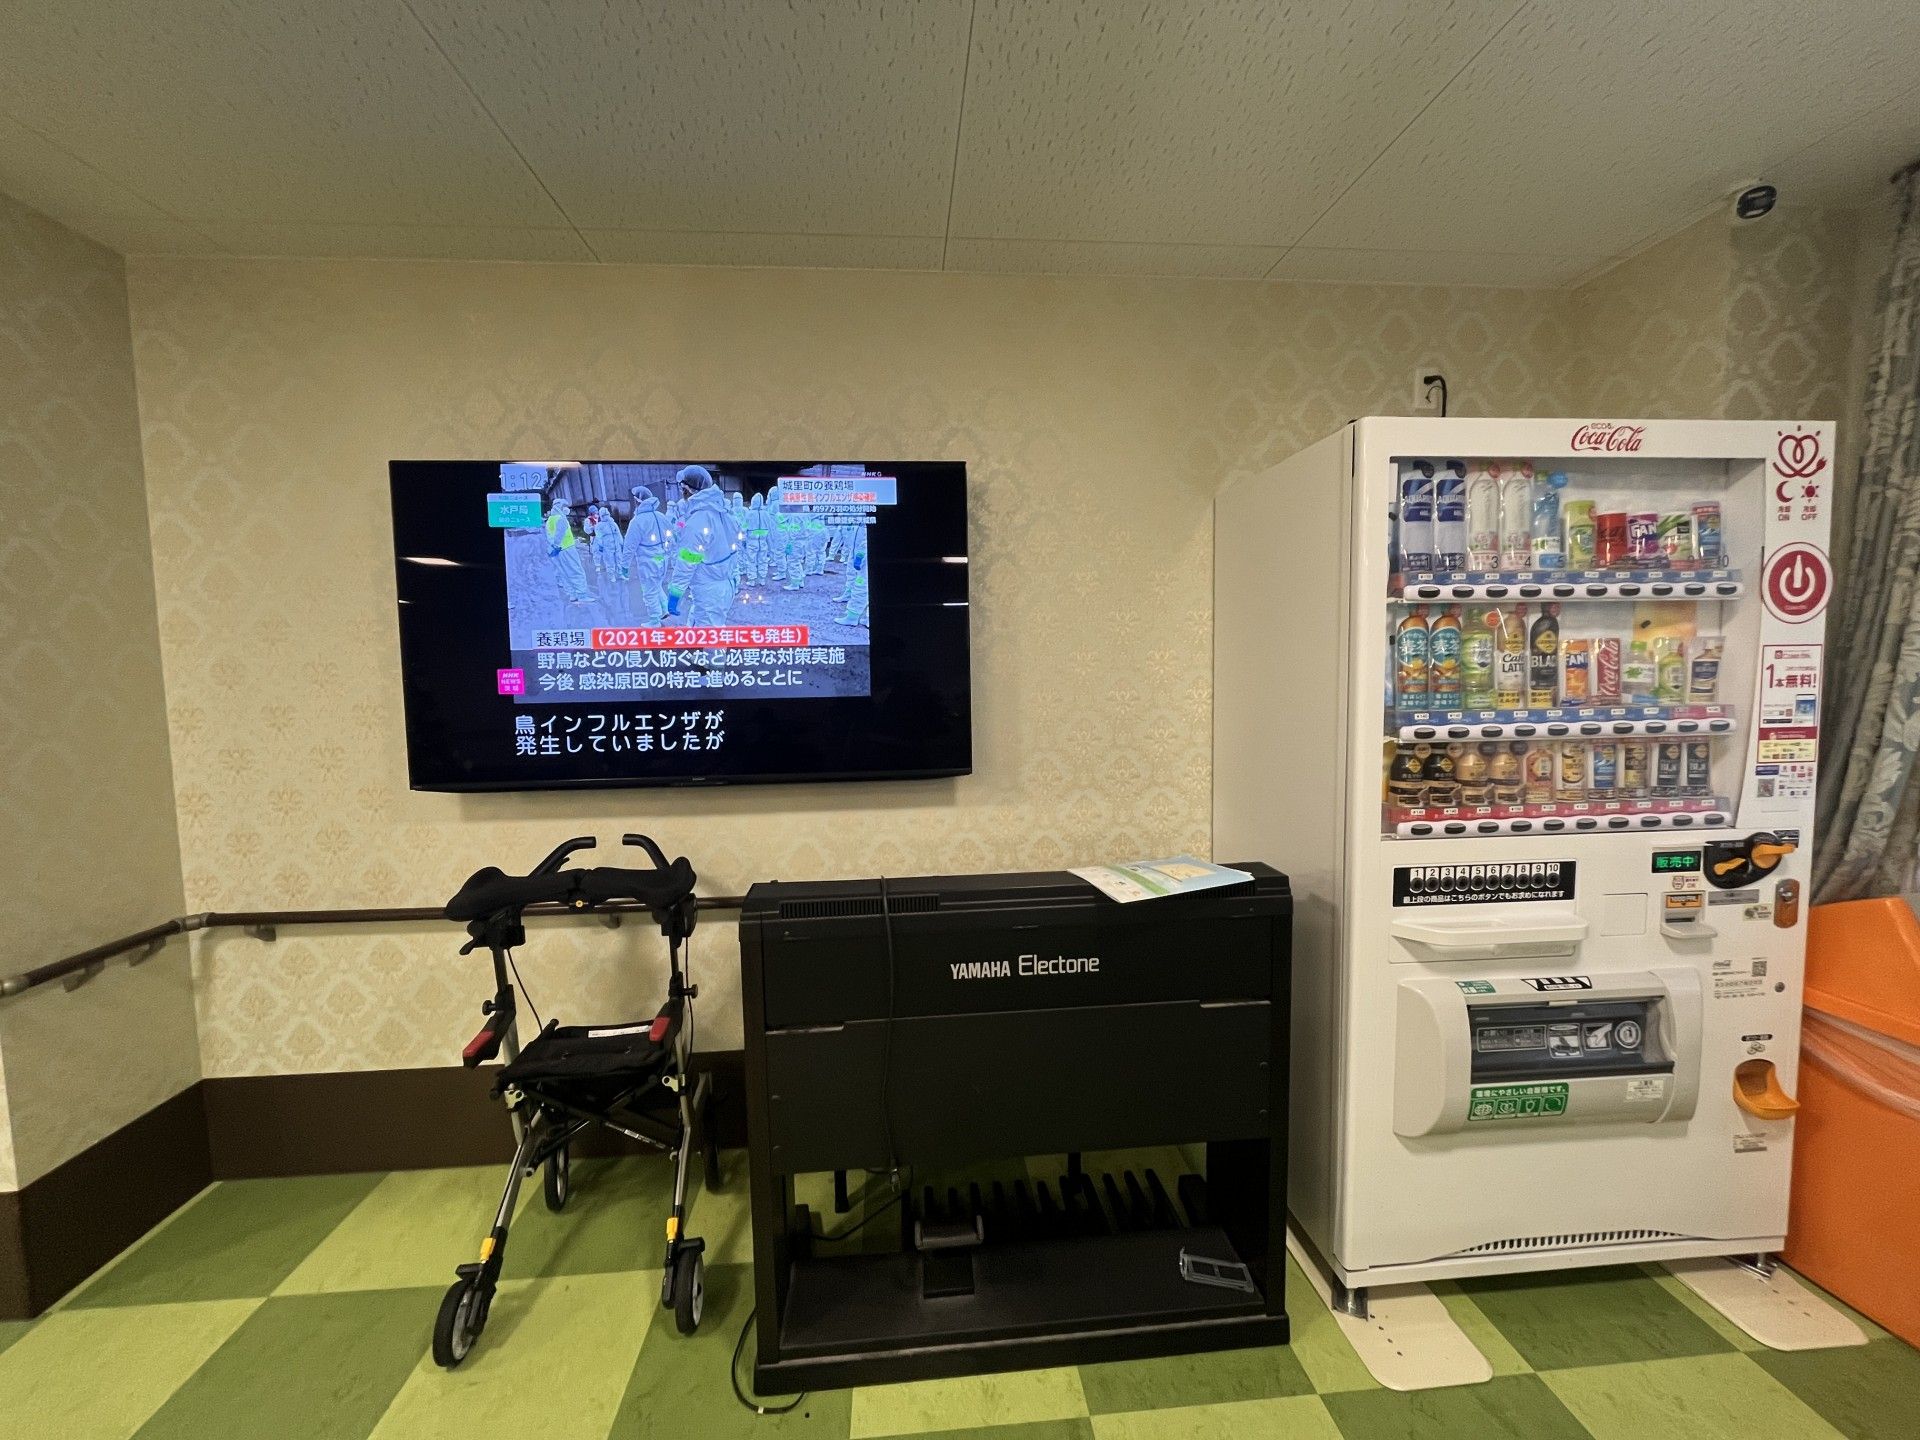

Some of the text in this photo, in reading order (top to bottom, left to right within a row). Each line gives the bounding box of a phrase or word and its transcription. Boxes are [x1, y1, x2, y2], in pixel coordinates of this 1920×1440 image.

[1571, 425, 1649, 451] Coca-Cola
[783, 480, 854, 491] 城里町の養鶏場
[500, 505, 529, 515] 水戸局
[1491, 556, 1498, 568] 3
[1524, 556, 1532, 567] 4
[537, 631, 585, 647] 養鶏場
[598, 628, 803, 646] (2021年・2023年にも発生)
[537, 647, 846, 670] 野鳥などの侵入防ぐなど必要な対策実施
[539, 669, 803, 691] 今後 感染原因の特定 進めることに
[515, 709, 725, 735] 鳥インフルエンザが
[515, 730, 726, 756] 発生していましたが
[1656, 856, 1695, 868] 販売中
[1415, 869, 1419, 877] 1
[1430, 869, 1435, 877] 2
[1445, 868, 1451, 876] 3
[1475, 867, 1481, 875] 5
[1491, 866, 1496, 874] 6
[1520, 865, 1526, 873] 8
[1536, 864, 1541, 872] 9
[1550, 864, 1558, 872] 10
[951, 954, 1100, 980] YAMAHA Electone
